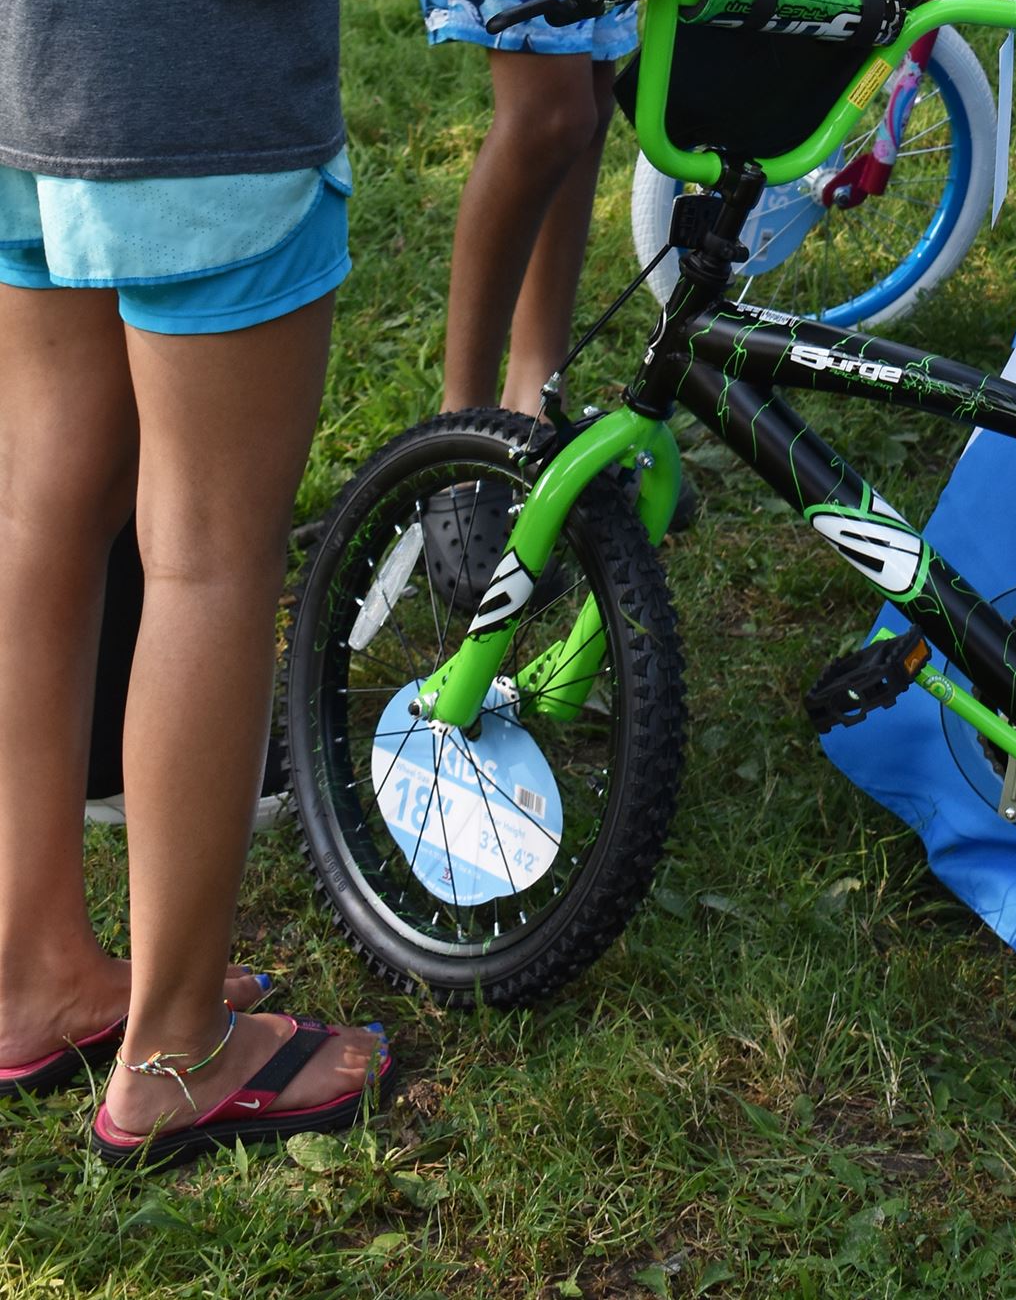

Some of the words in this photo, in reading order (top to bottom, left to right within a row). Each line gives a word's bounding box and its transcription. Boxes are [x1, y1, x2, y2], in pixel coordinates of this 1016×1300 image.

[790, 345, 904, 384] Surge
[440, 741, 498, 795] KIDS
[395, 777, 453, 832] 18"
